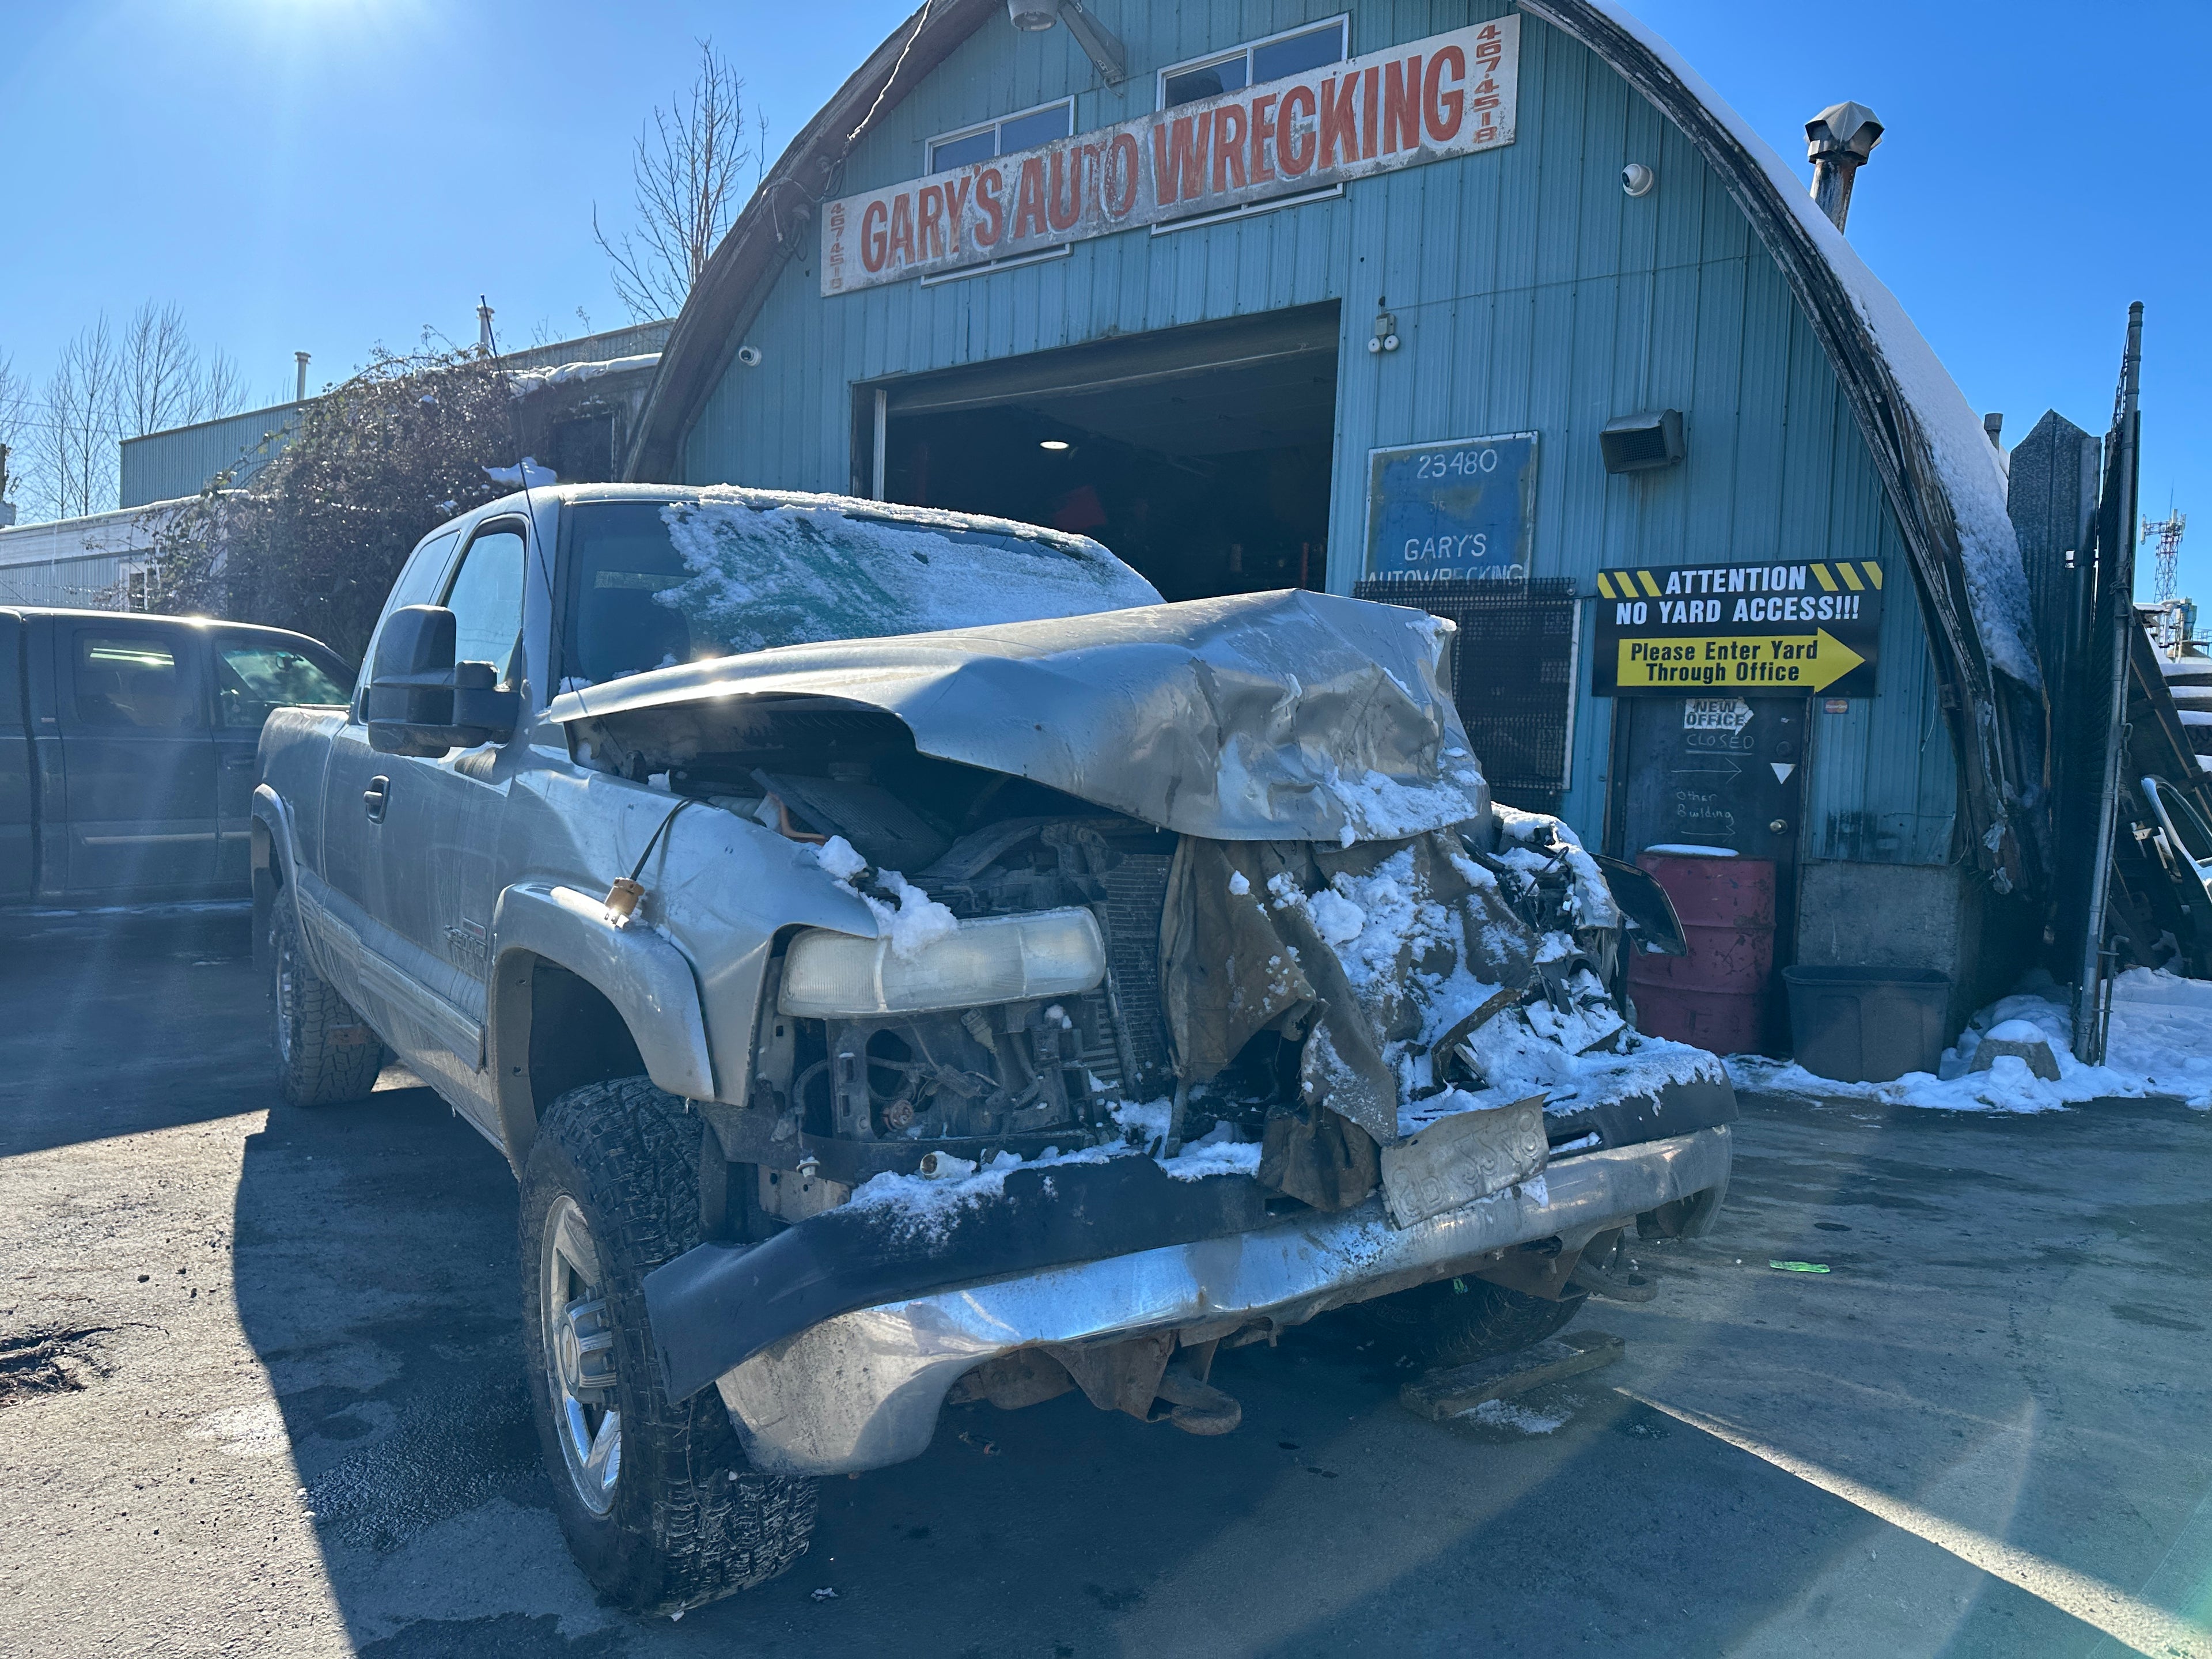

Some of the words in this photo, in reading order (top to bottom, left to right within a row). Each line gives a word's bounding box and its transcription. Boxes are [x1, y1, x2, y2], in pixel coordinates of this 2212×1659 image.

[861, 165, 1003, 273] GARY'S
[1014, 133, 1139, 238] AUTO
[1154, 46, 1465, 206] WRECKING
[1416, 449, 1498, 479] 23480
[1404, 533, 1487, 561] GARY'S
[1665, 566, 1806, 595] ATTENTION
[1616, 602, 1647, 625] NO
[1659, 599, 1721, 624] YARD
[1732, 595, 1860, 622] ACCESS!!!
[1631, 643, 1695, 661] Please
[1705, 641, 1760, 660] Enter
[1771, 640, 1818, 660] Yard
[1646, 663, 1726, 684] Through
[1736, 662, 1800, 681] Office
[1694, 699, 1735, 713] NEW
[1686, 712, 1745, 726] OFFICE
[1687, 733, 1755, 749] CLOSED
